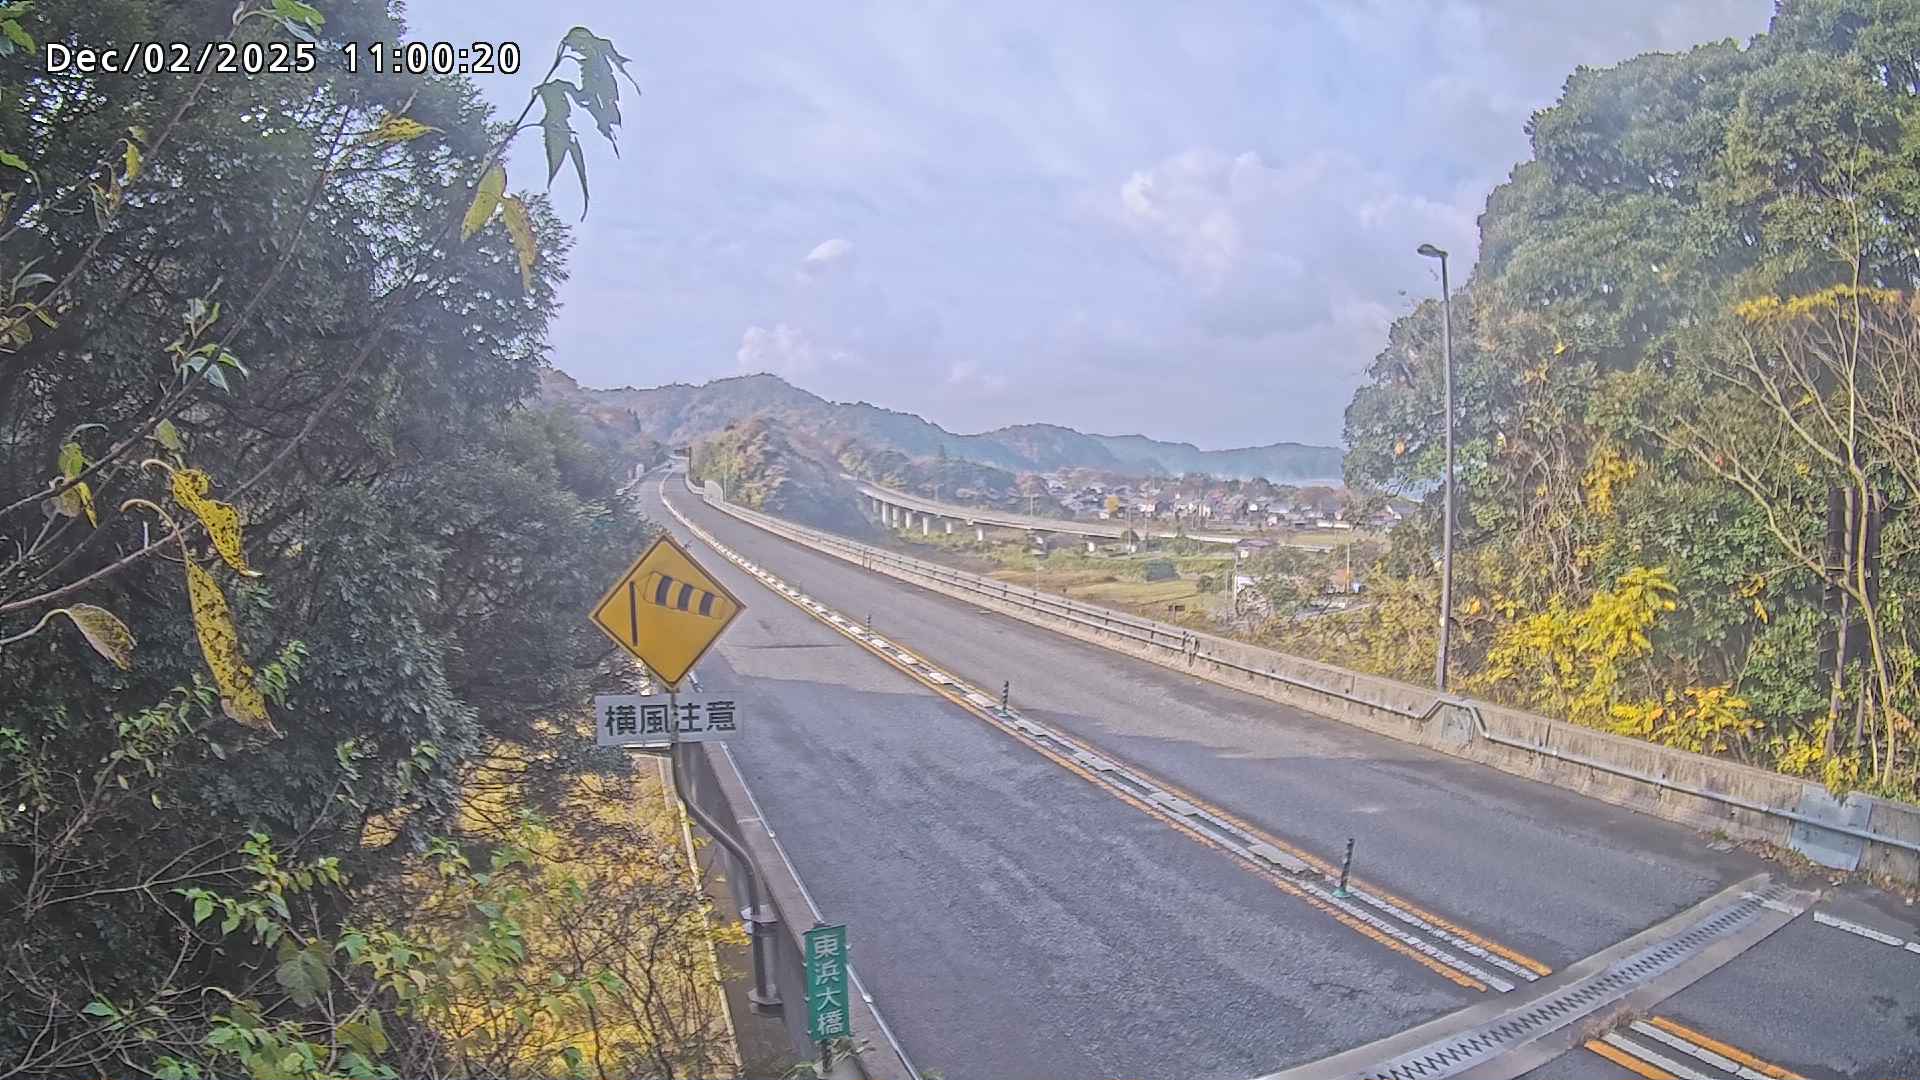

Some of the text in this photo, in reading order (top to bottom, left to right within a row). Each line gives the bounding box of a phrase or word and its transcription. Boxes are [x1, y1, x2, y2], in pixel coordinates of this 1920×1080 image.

[604, 701, 737, 737] 横風注意
[813, 933, 843, 1036] 東浜大橋
